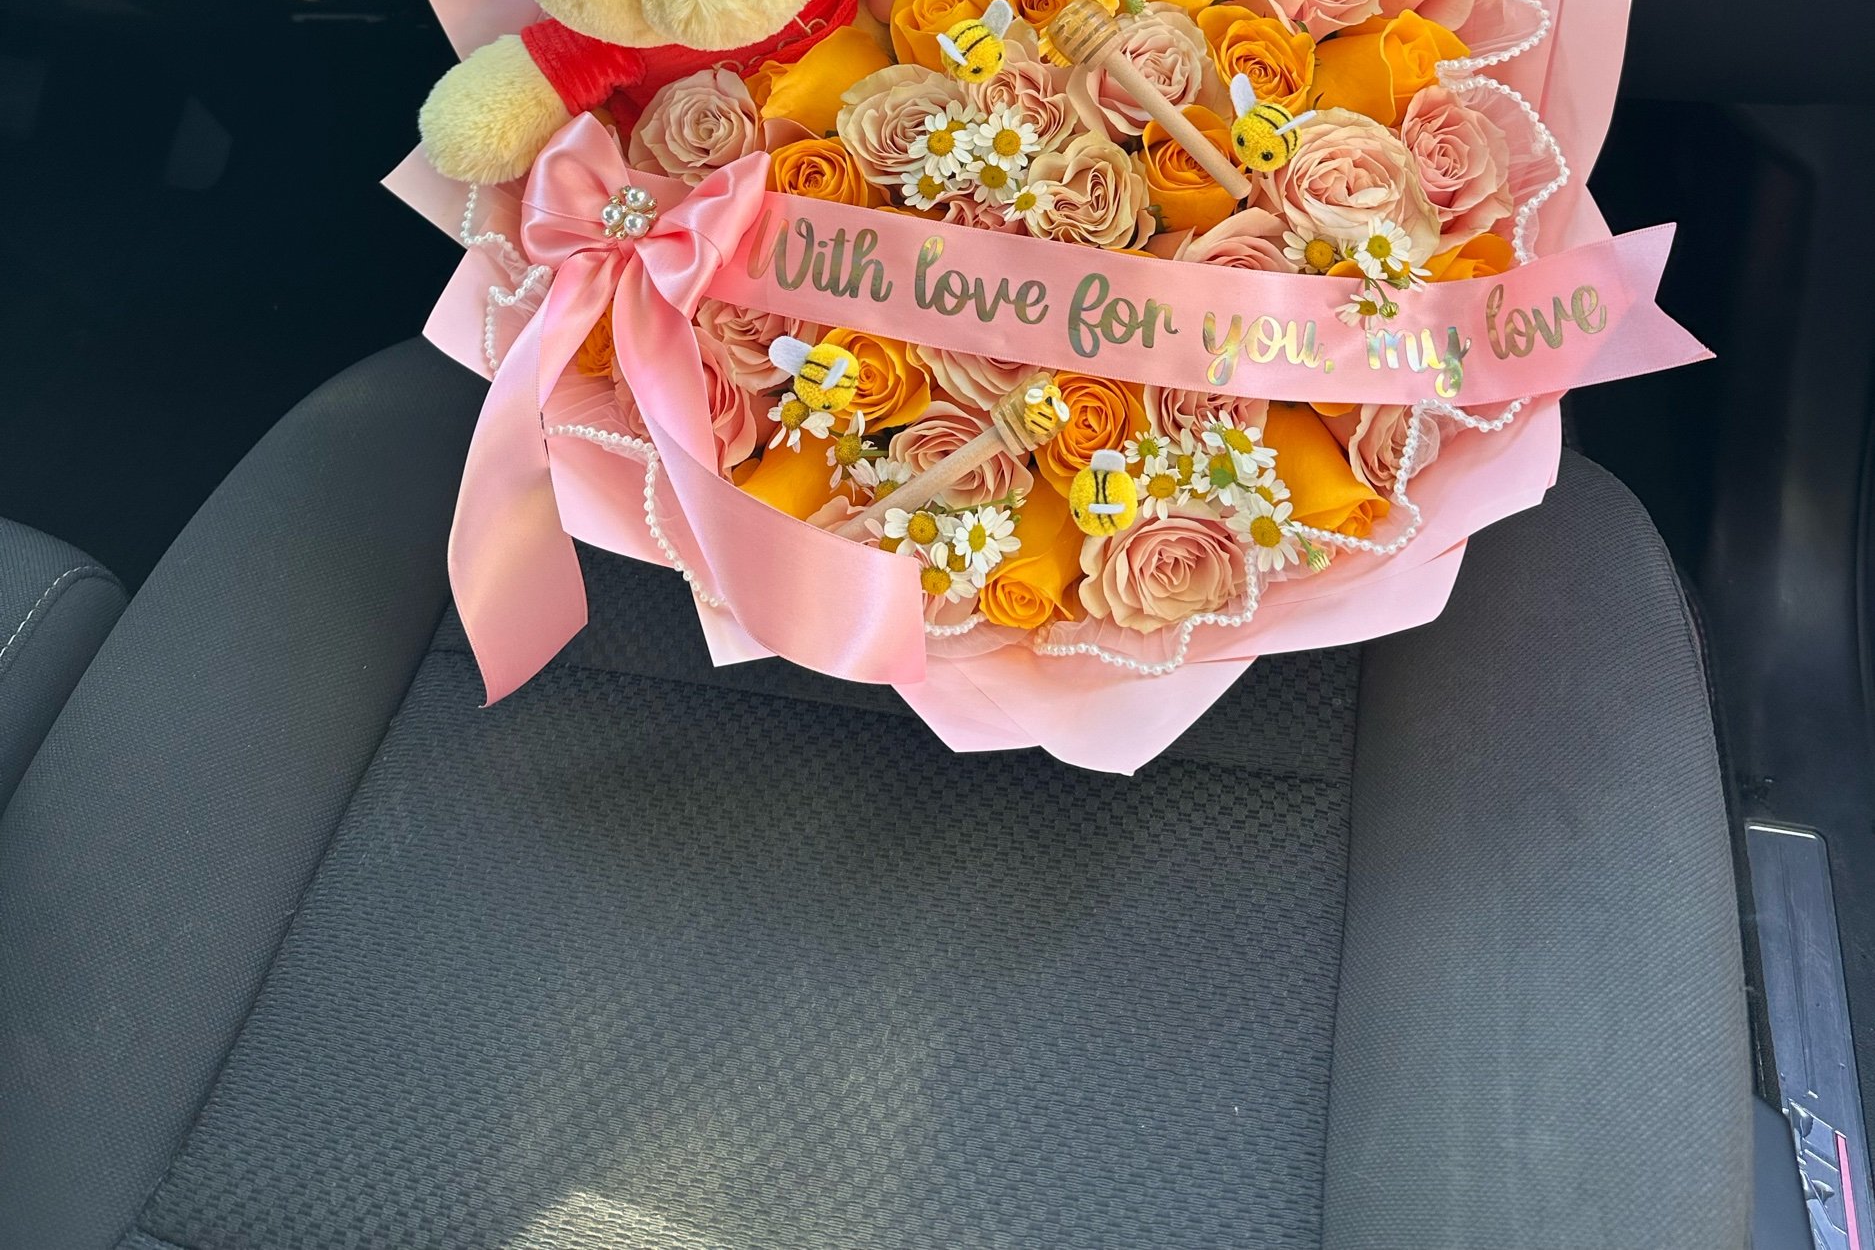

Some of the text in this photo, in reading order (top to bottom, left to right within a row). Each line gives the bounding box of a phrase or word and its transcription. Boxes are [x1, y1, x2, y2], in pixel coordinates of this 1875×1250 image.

[747, 209, 893, 303] With
[914, 236, 1049, 324] love
[1067, 272, 1181, 358] for
[1365, 324, 1472, 399] my
[1485, 283, 1608, 361] love
